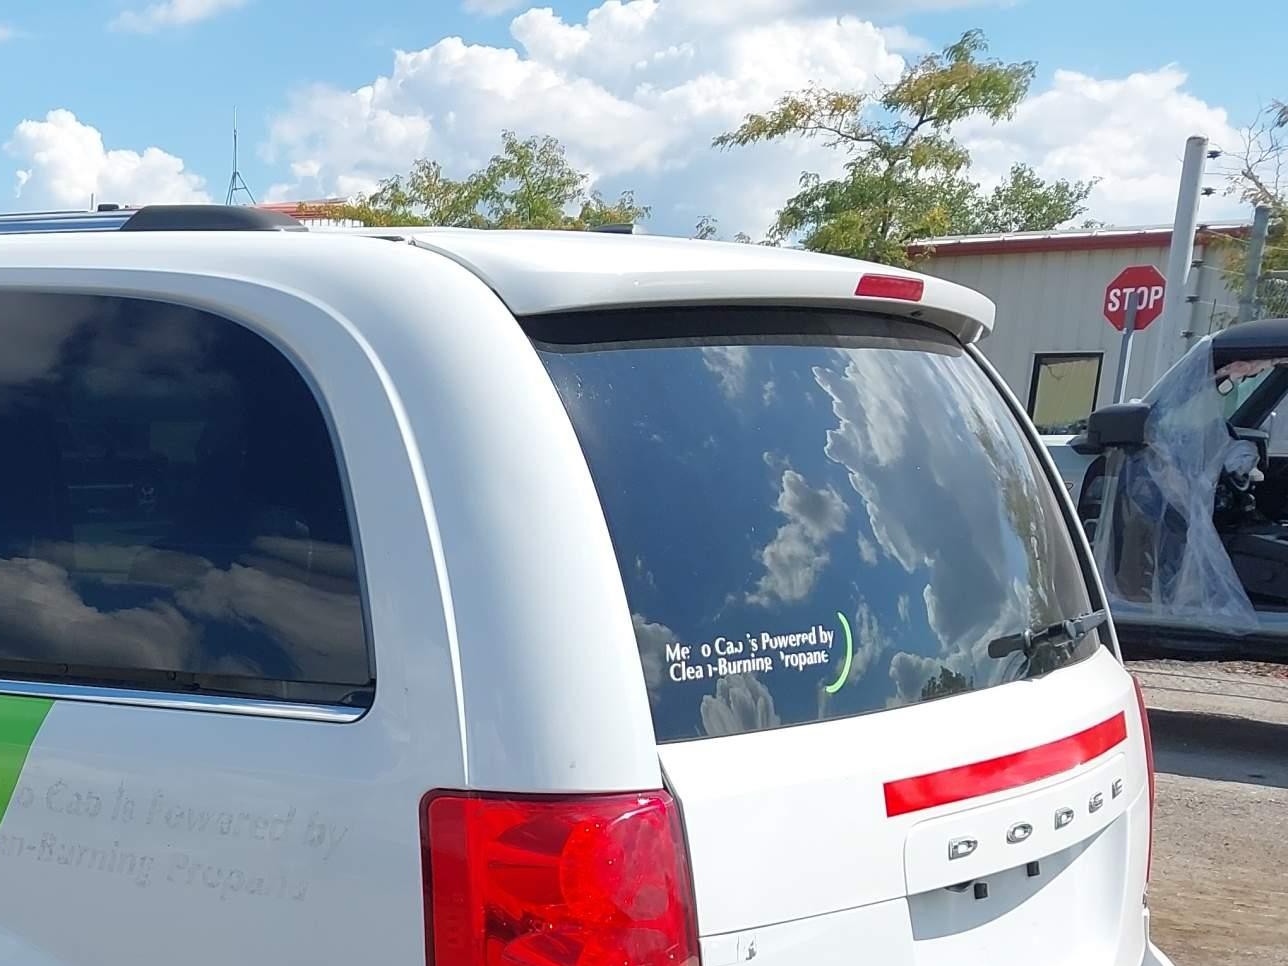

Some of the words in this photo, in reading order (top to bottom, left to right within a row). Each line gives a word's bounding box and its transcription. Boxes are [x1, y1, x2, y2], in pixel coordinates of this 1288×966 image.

[1107, 285, 1164, 312] STOP
[665, 642, 712, 662] Meo
[760, 626, 817, 650] Powered
[818, 625, 834, 649] by
[948, 776, 1124, 862] DODGE
